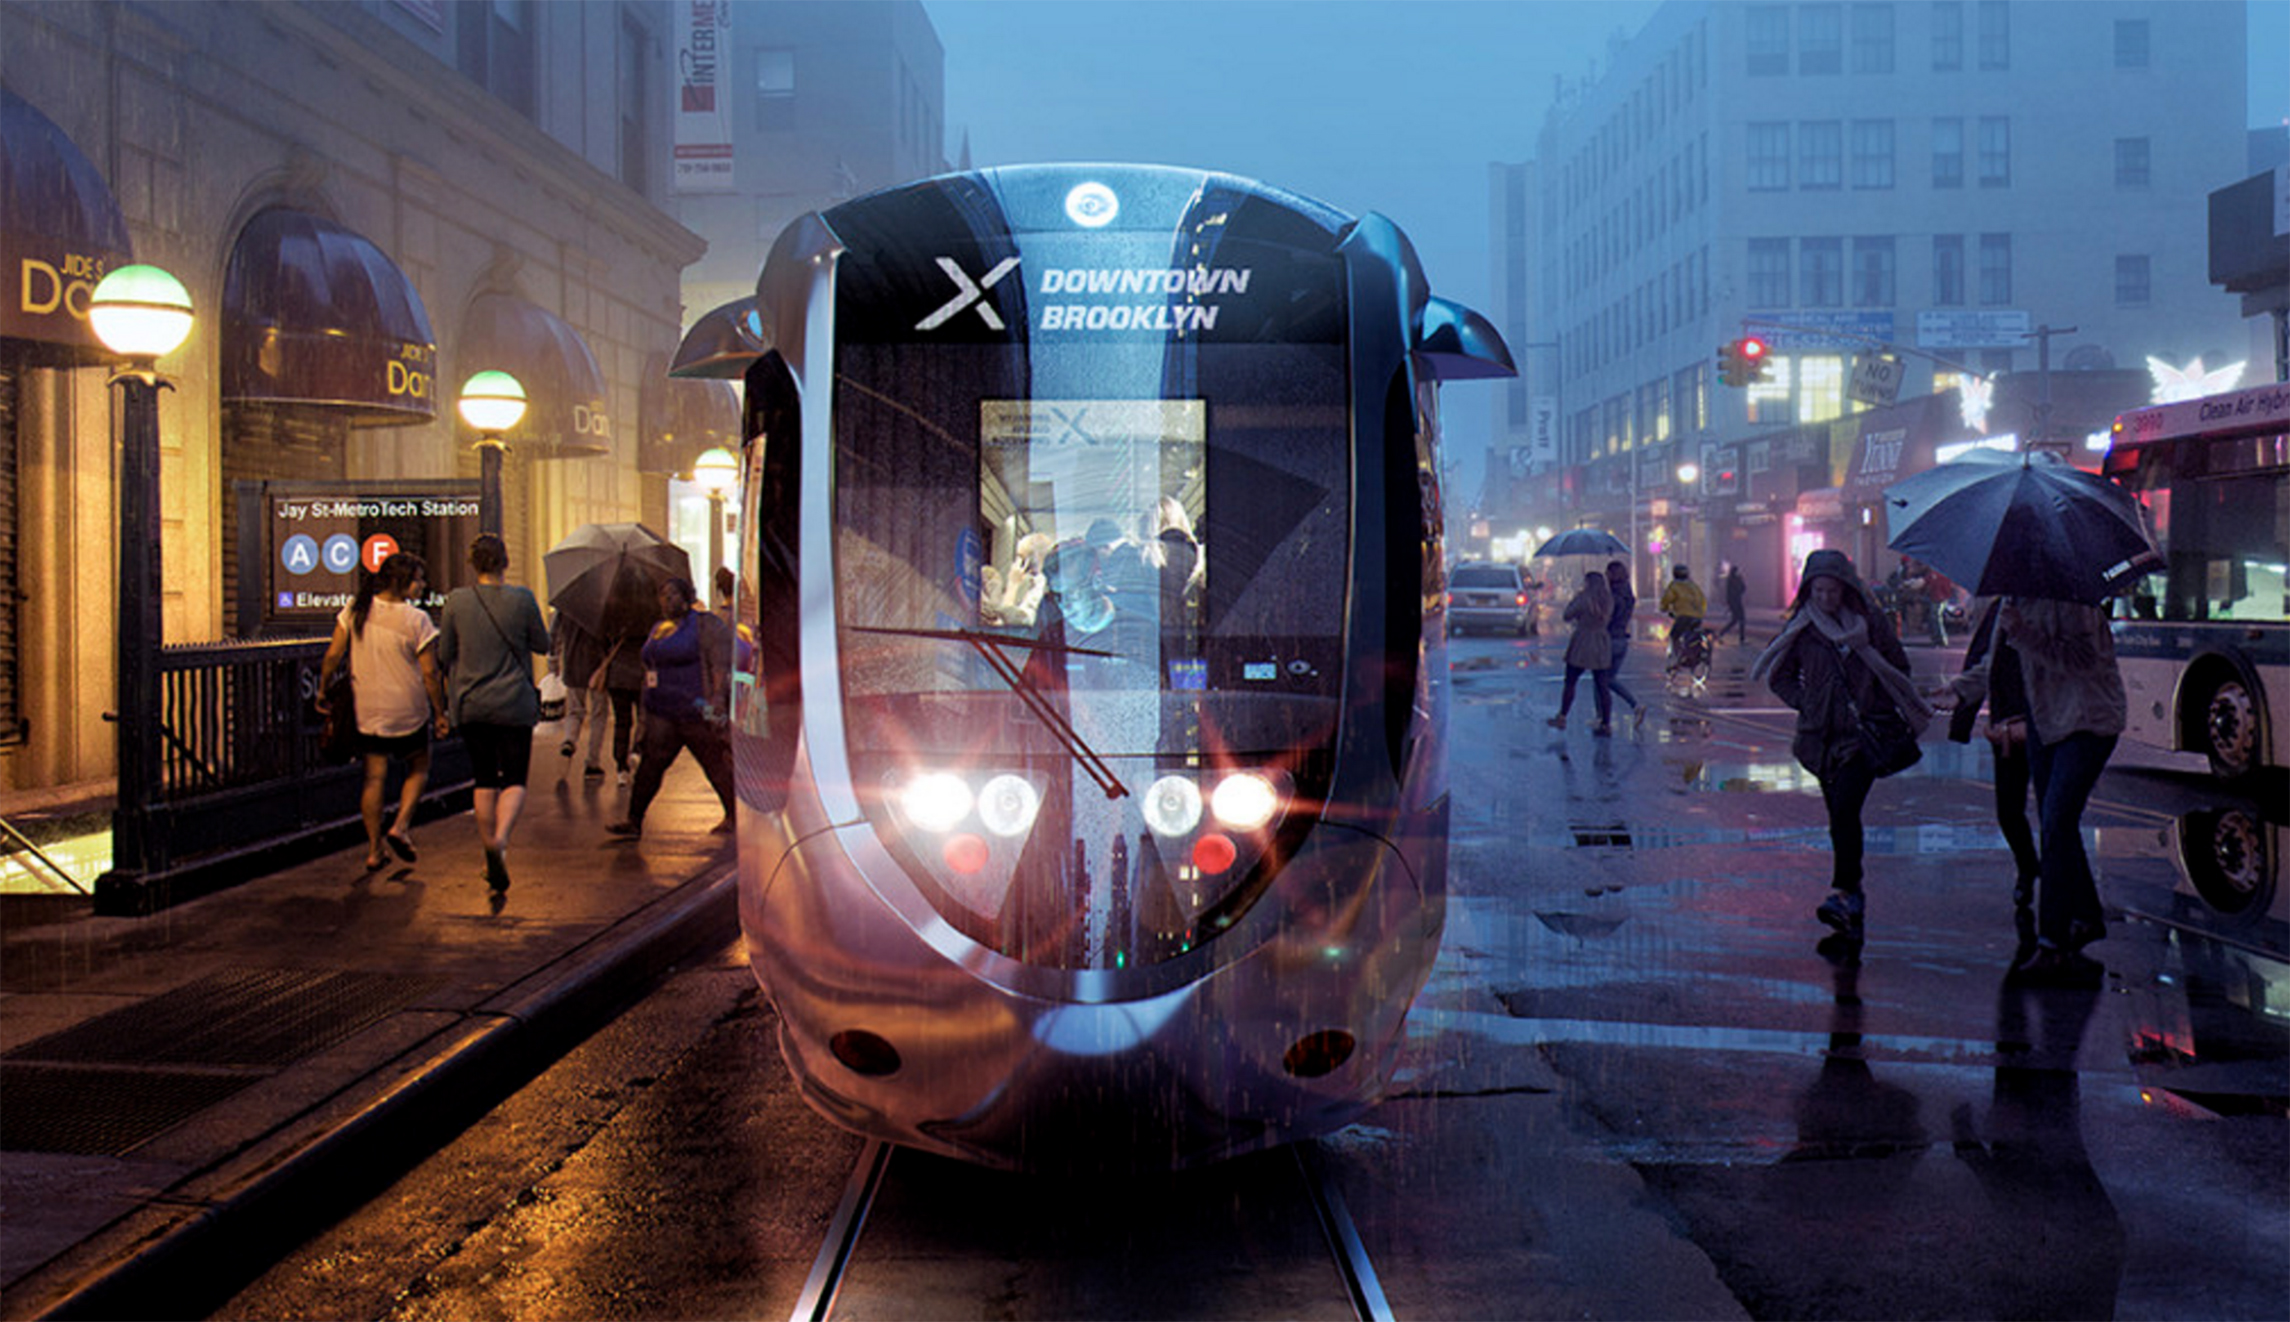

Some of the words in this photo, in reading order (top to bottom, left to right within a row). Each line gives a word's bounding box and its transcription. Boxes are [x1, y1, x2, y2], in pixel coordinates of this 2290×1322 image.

[1039, 268, 1252, 294] DOWNTOWN
[1039, 305, 1220, 331] BROOKLYN
[1865, 362, 1891, 383] NO
[2200, 401, 2233, 422] Clean
[2234, 394, 2256, 416] Air
[277, 503, 307, 521] Jay
[311, 501, 418, 518] St-MetroTech
[421, 500, 480, 517] Station
[289, 542, 312, 567] A
[330, 541, 350, 567] C
[372, 541, 390, 566] F
